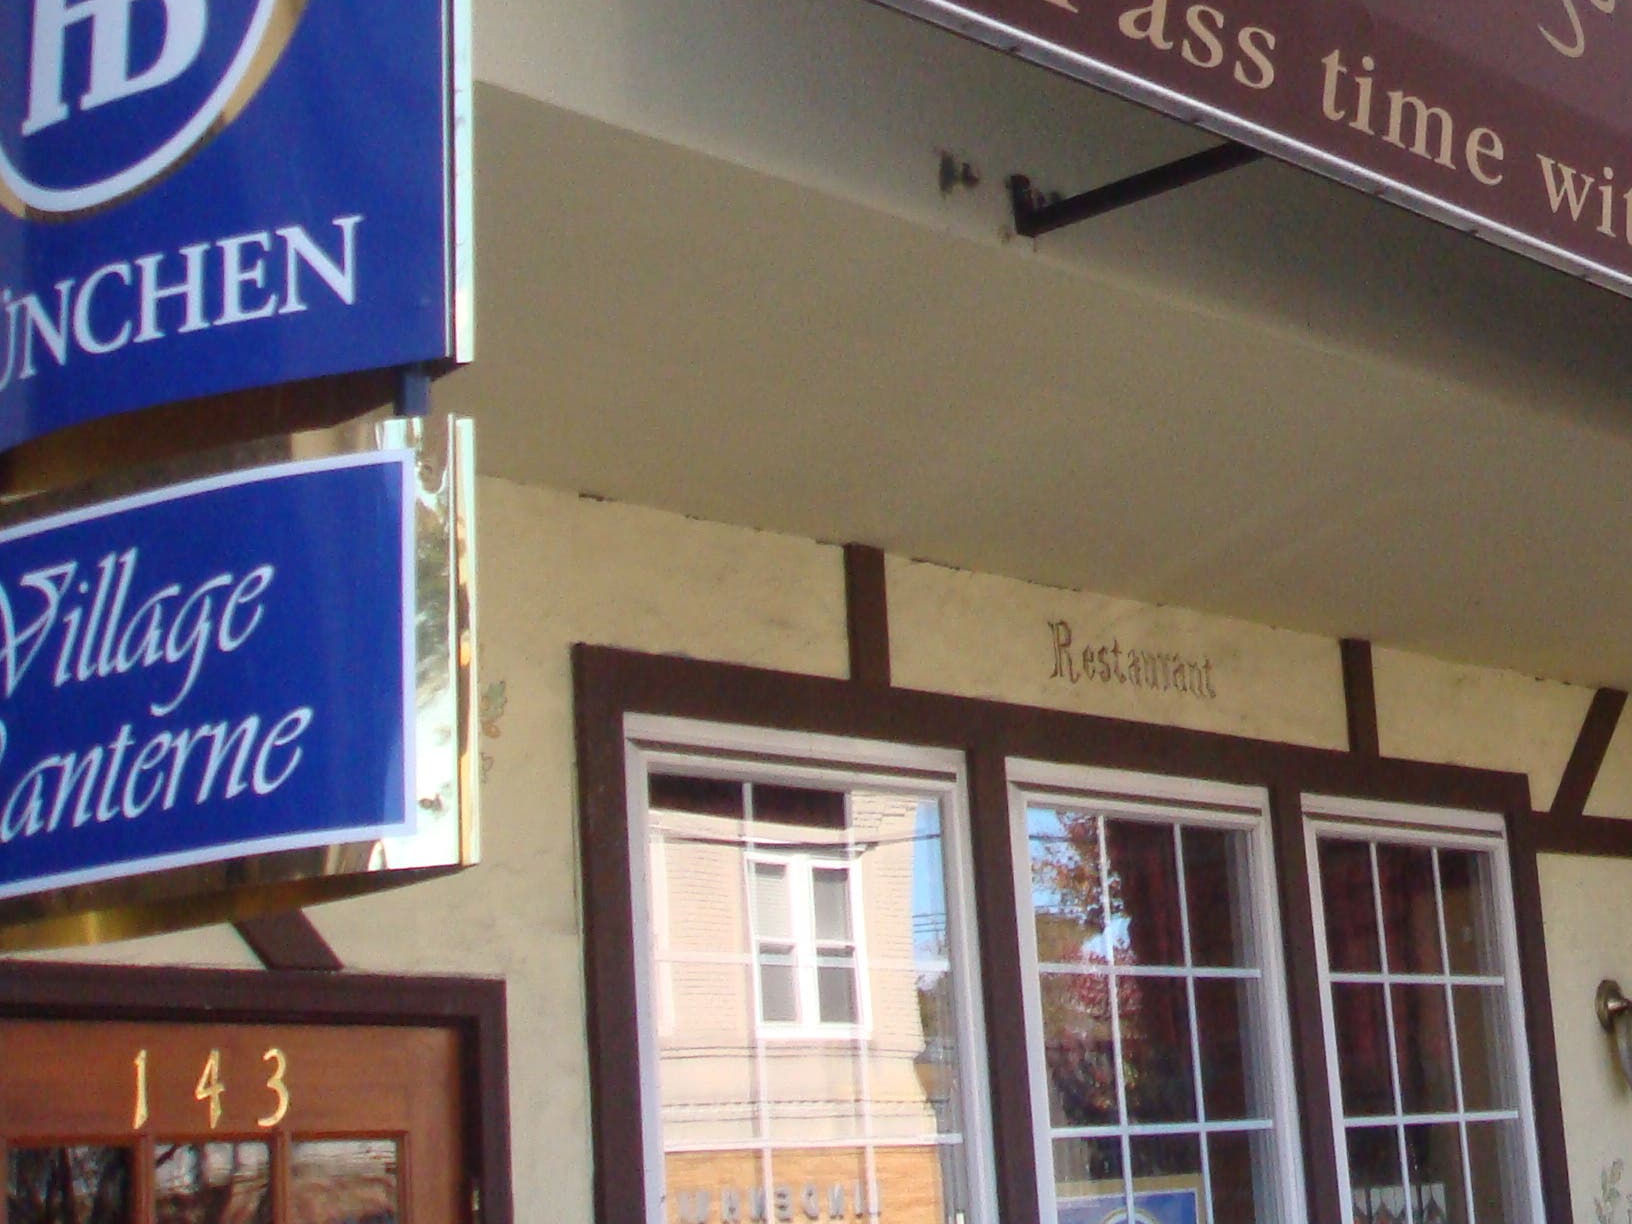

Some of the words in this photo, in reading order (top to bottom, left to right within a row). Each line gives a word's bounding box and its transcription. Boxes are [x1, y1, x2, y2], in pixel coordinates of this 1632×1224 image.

[1320, 48, 1504, 186] time
[0, 546, 275, 717] Village
[1047, 619, 1217, 699] Restaurant
[0, 705, 314, 844] anterne
[132, 1049, 290, 1130] 143
